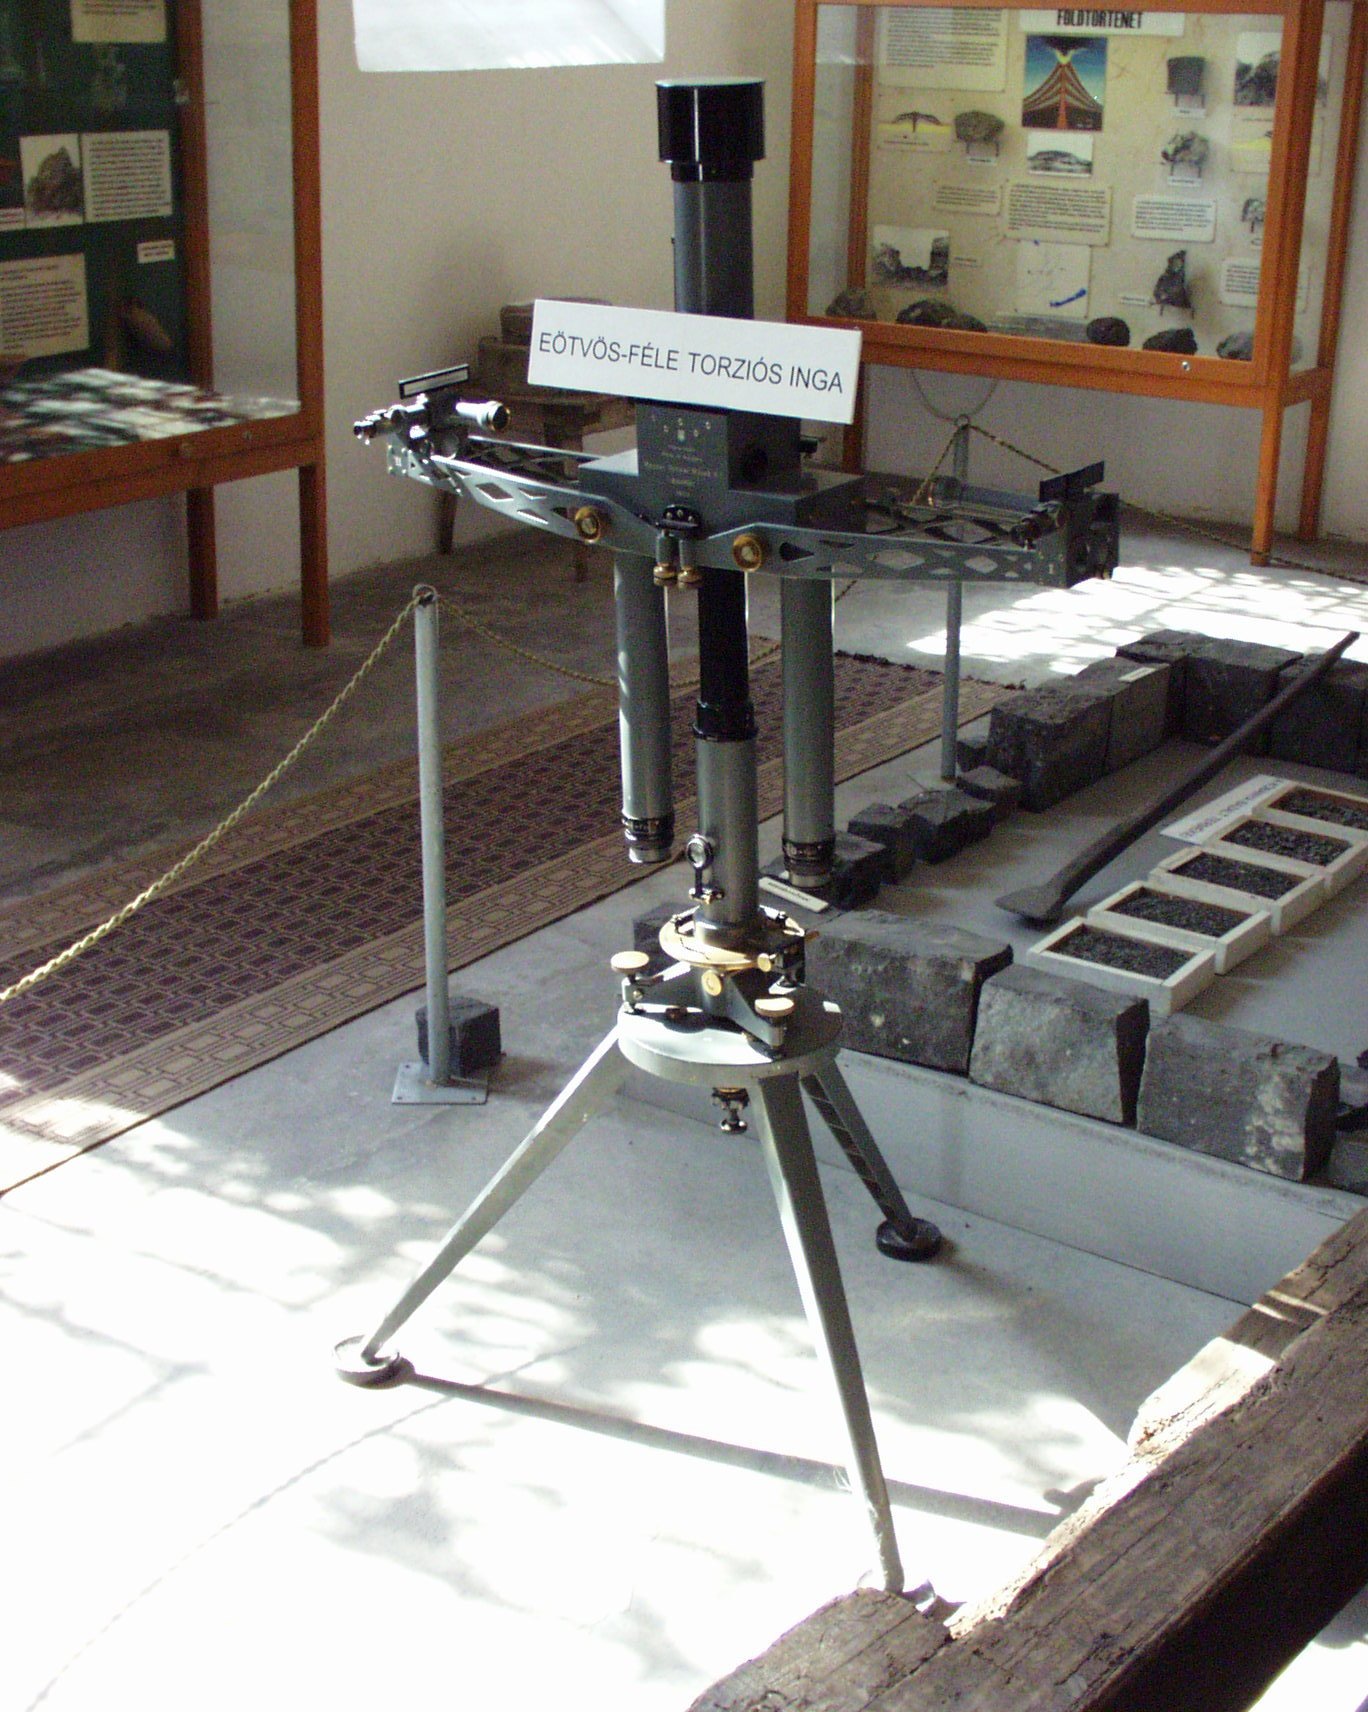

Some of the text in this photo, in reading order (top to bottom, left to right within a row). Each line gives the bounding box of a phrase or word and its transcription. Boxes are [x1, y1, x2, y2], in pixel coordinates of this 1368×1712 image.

[539, 331, 844, 394] EÖTVÖS-FÉLE TORZIÓS INGA
